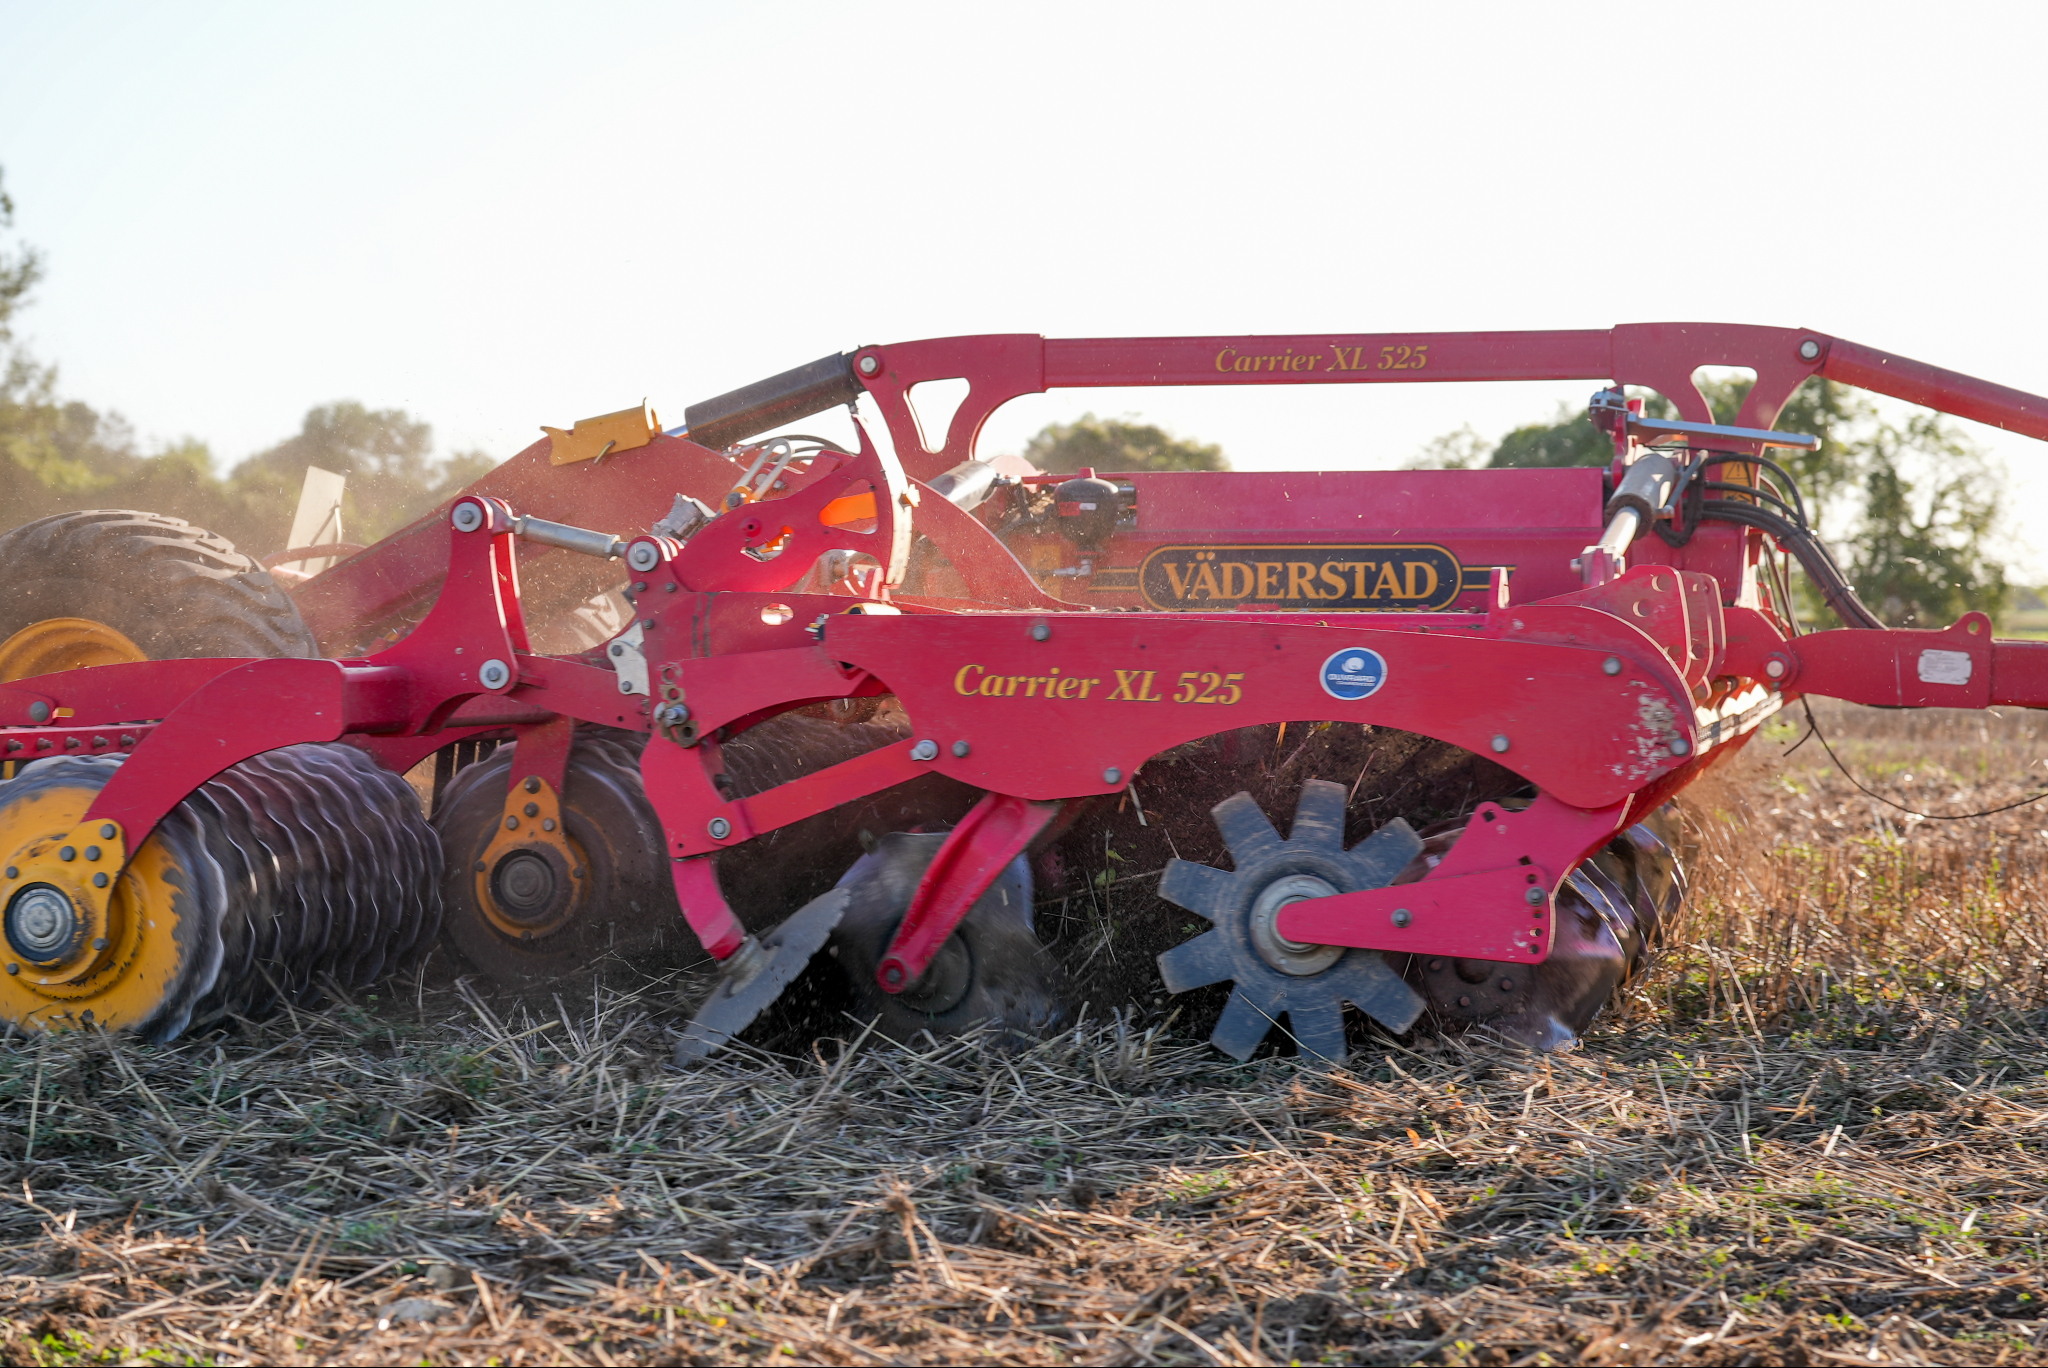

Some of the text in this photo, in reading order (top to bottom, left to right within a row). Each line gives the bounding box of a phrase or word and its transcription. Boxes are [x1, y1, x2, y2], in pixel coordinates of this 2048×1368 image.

[1215, 345, 1429, 372] Carrier XL 525
[1162, 551, 1439, 600] VÄDERSTAD
[953, 664, 1245, 705] Carrier XL 525
